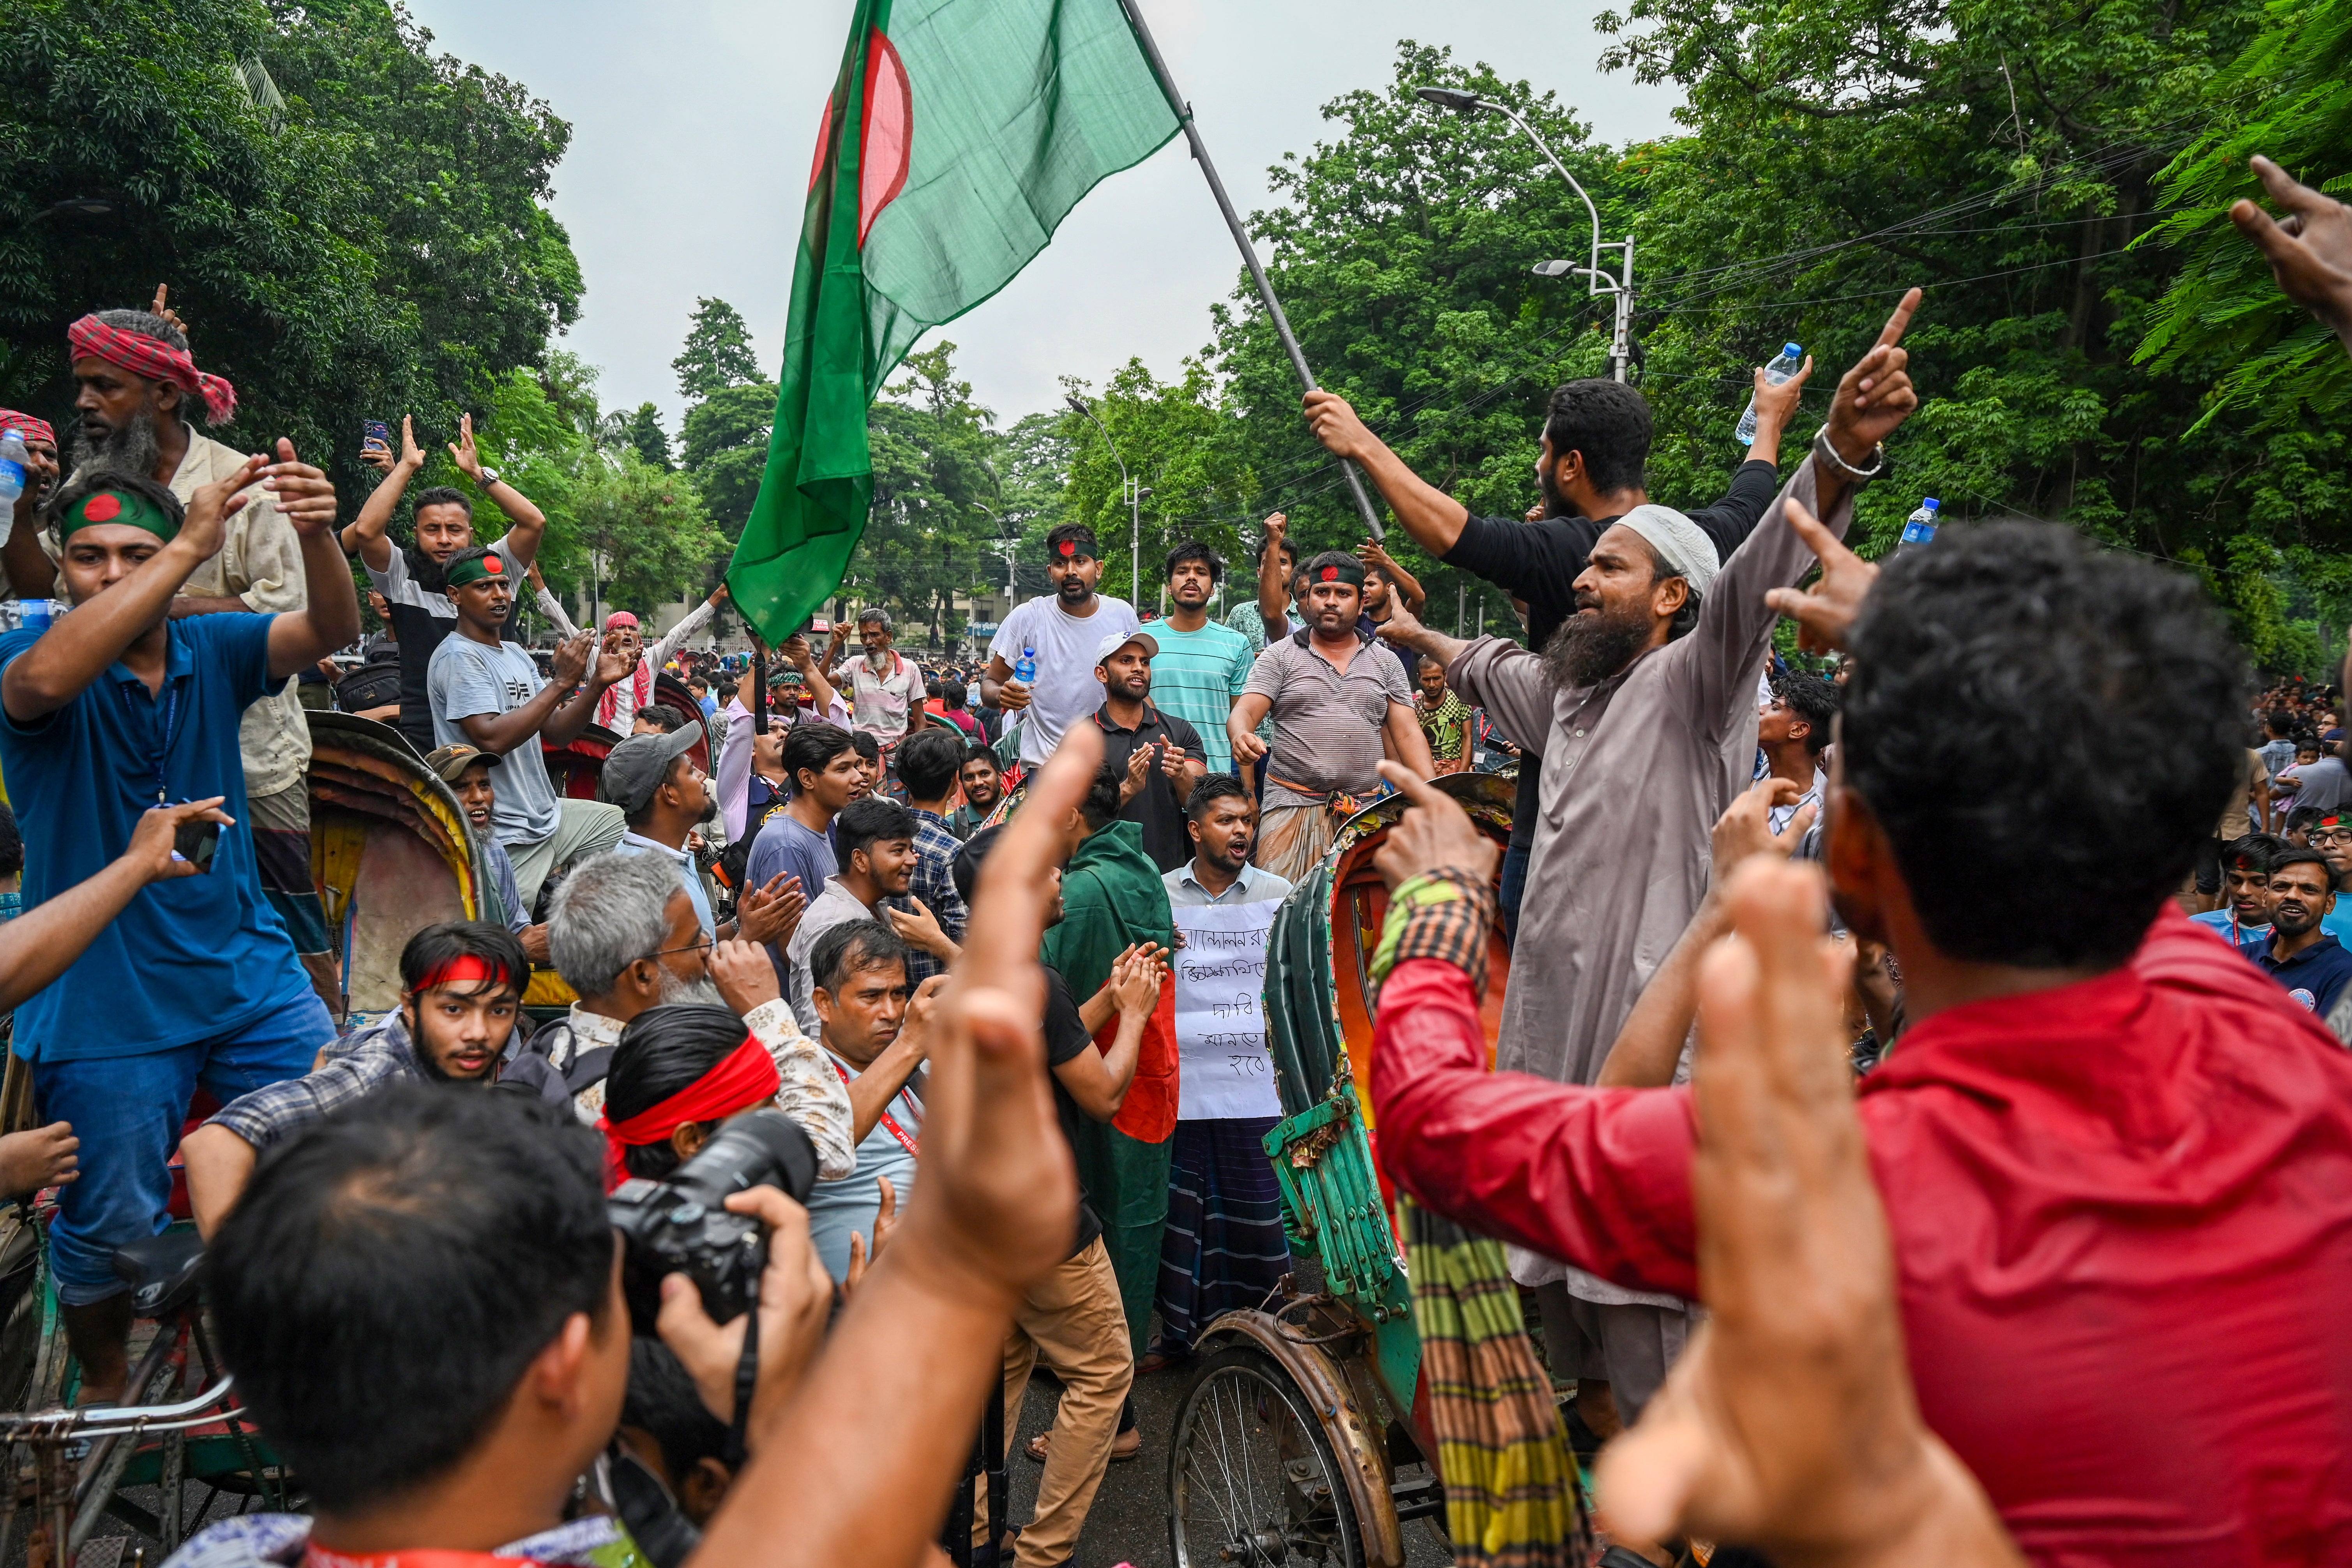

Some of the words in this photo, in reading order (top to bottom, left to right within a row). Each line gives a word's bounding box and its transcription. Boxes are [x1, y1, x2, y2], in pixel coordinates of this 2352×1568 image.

[1213, 992, 1252, 1019] দাবি
[1197, 1032, 1265, 1047] মানতে
[1228, 1055, 1264, 1075] হবে
[897, 1130, 920, 1155] PRESS
